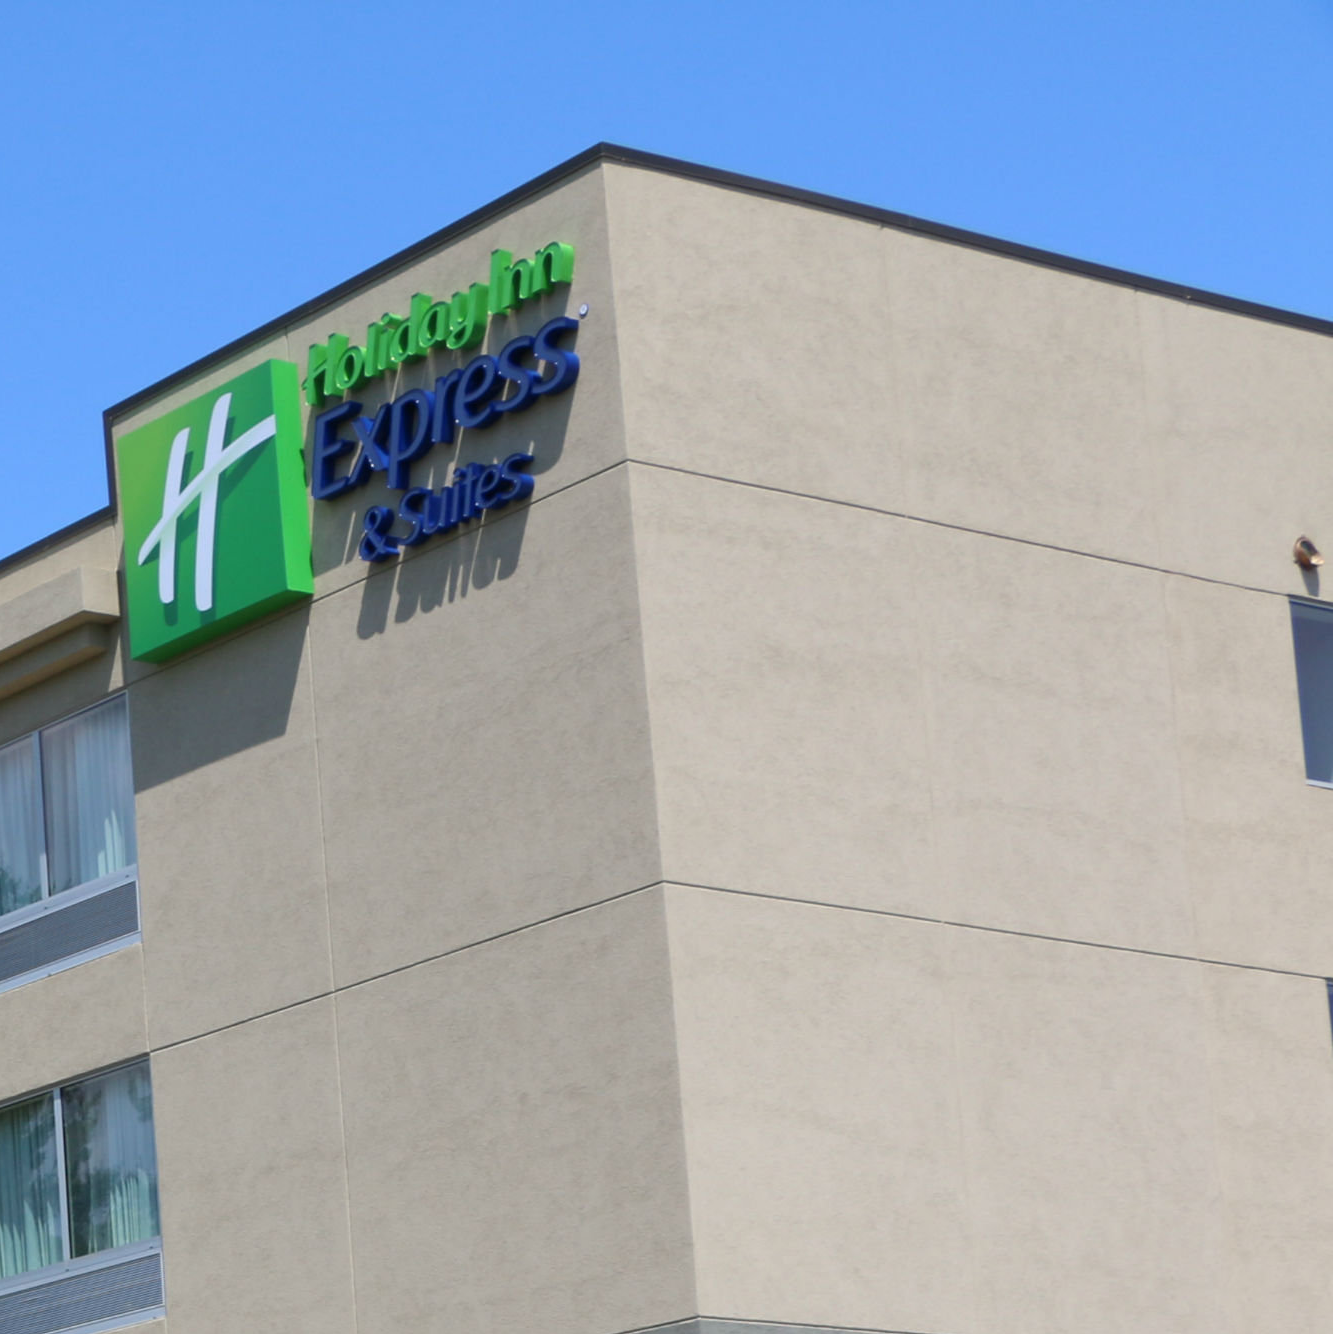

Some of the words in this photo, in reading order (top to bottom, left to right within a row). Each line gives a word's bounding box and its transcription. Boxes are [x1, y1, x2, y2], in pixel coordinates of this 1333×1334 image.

[301, 282, 488, 406] Holiday
[488, 241, 575, 315] Inn
[311, 316, 580, 501] Express
[358, 505, 401, 563] &
[397, 452, 535, 548] Suites
